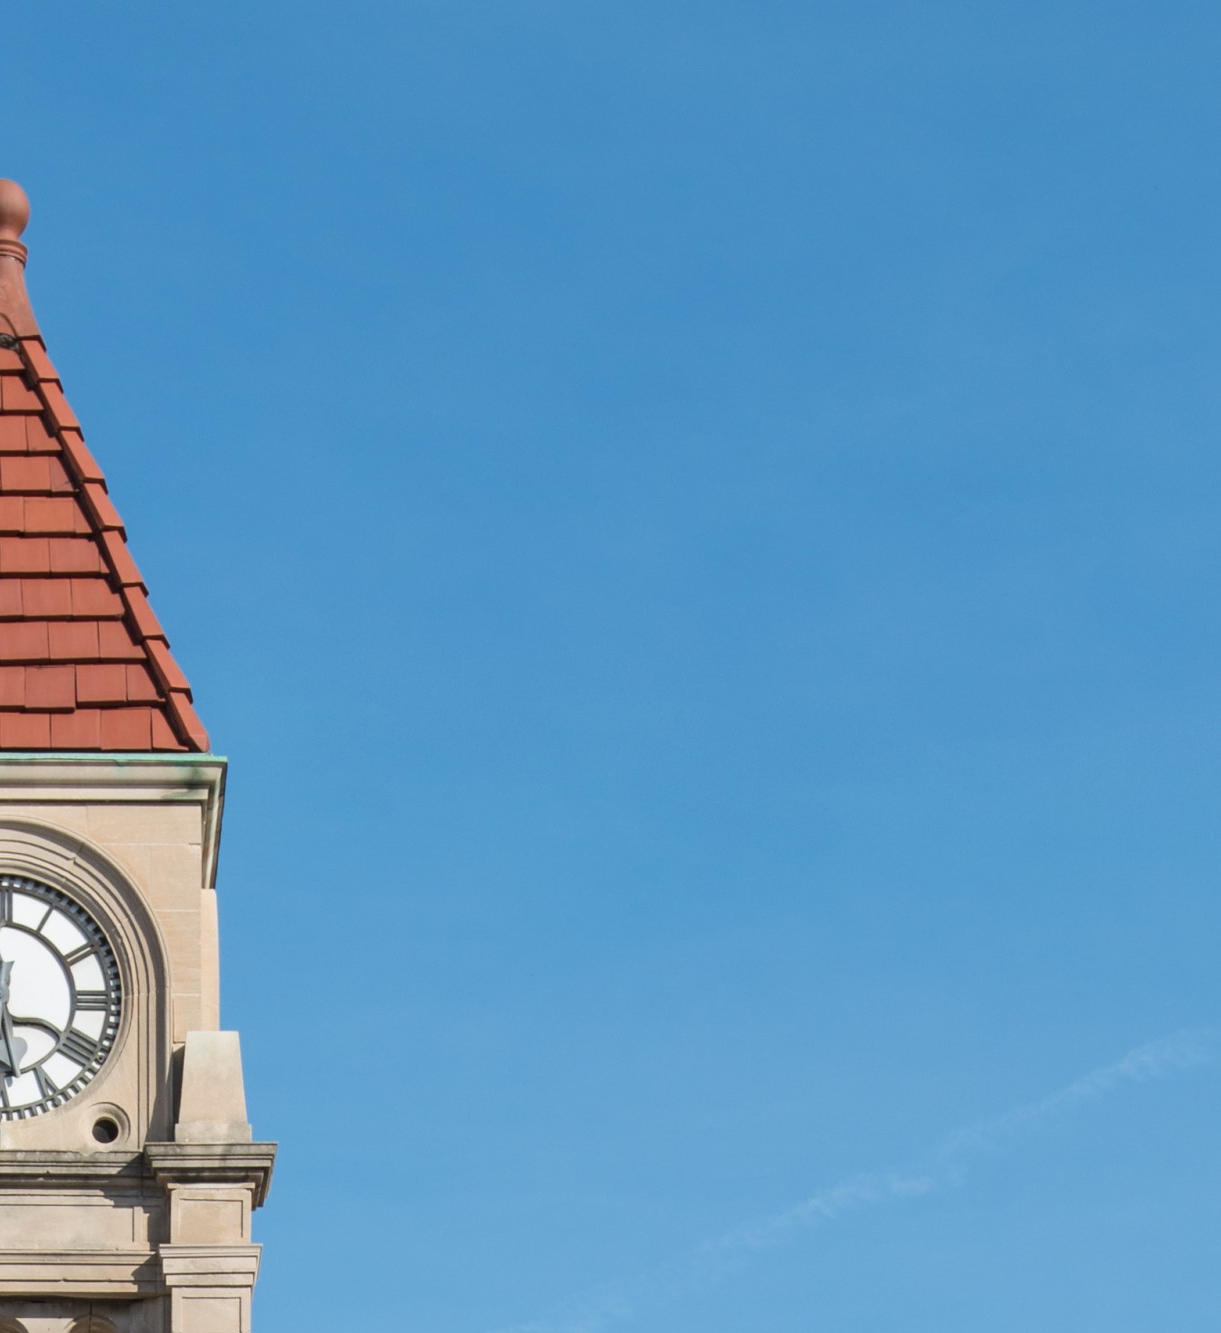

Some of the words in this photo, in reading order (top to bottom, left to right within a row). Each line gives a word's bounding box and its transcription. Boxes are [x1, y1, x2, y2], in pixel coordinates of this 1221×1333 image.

[64, 941, 101, 966] II
[75, 989, 108, 1011] III
[33, 1065, 61, 1097] V
